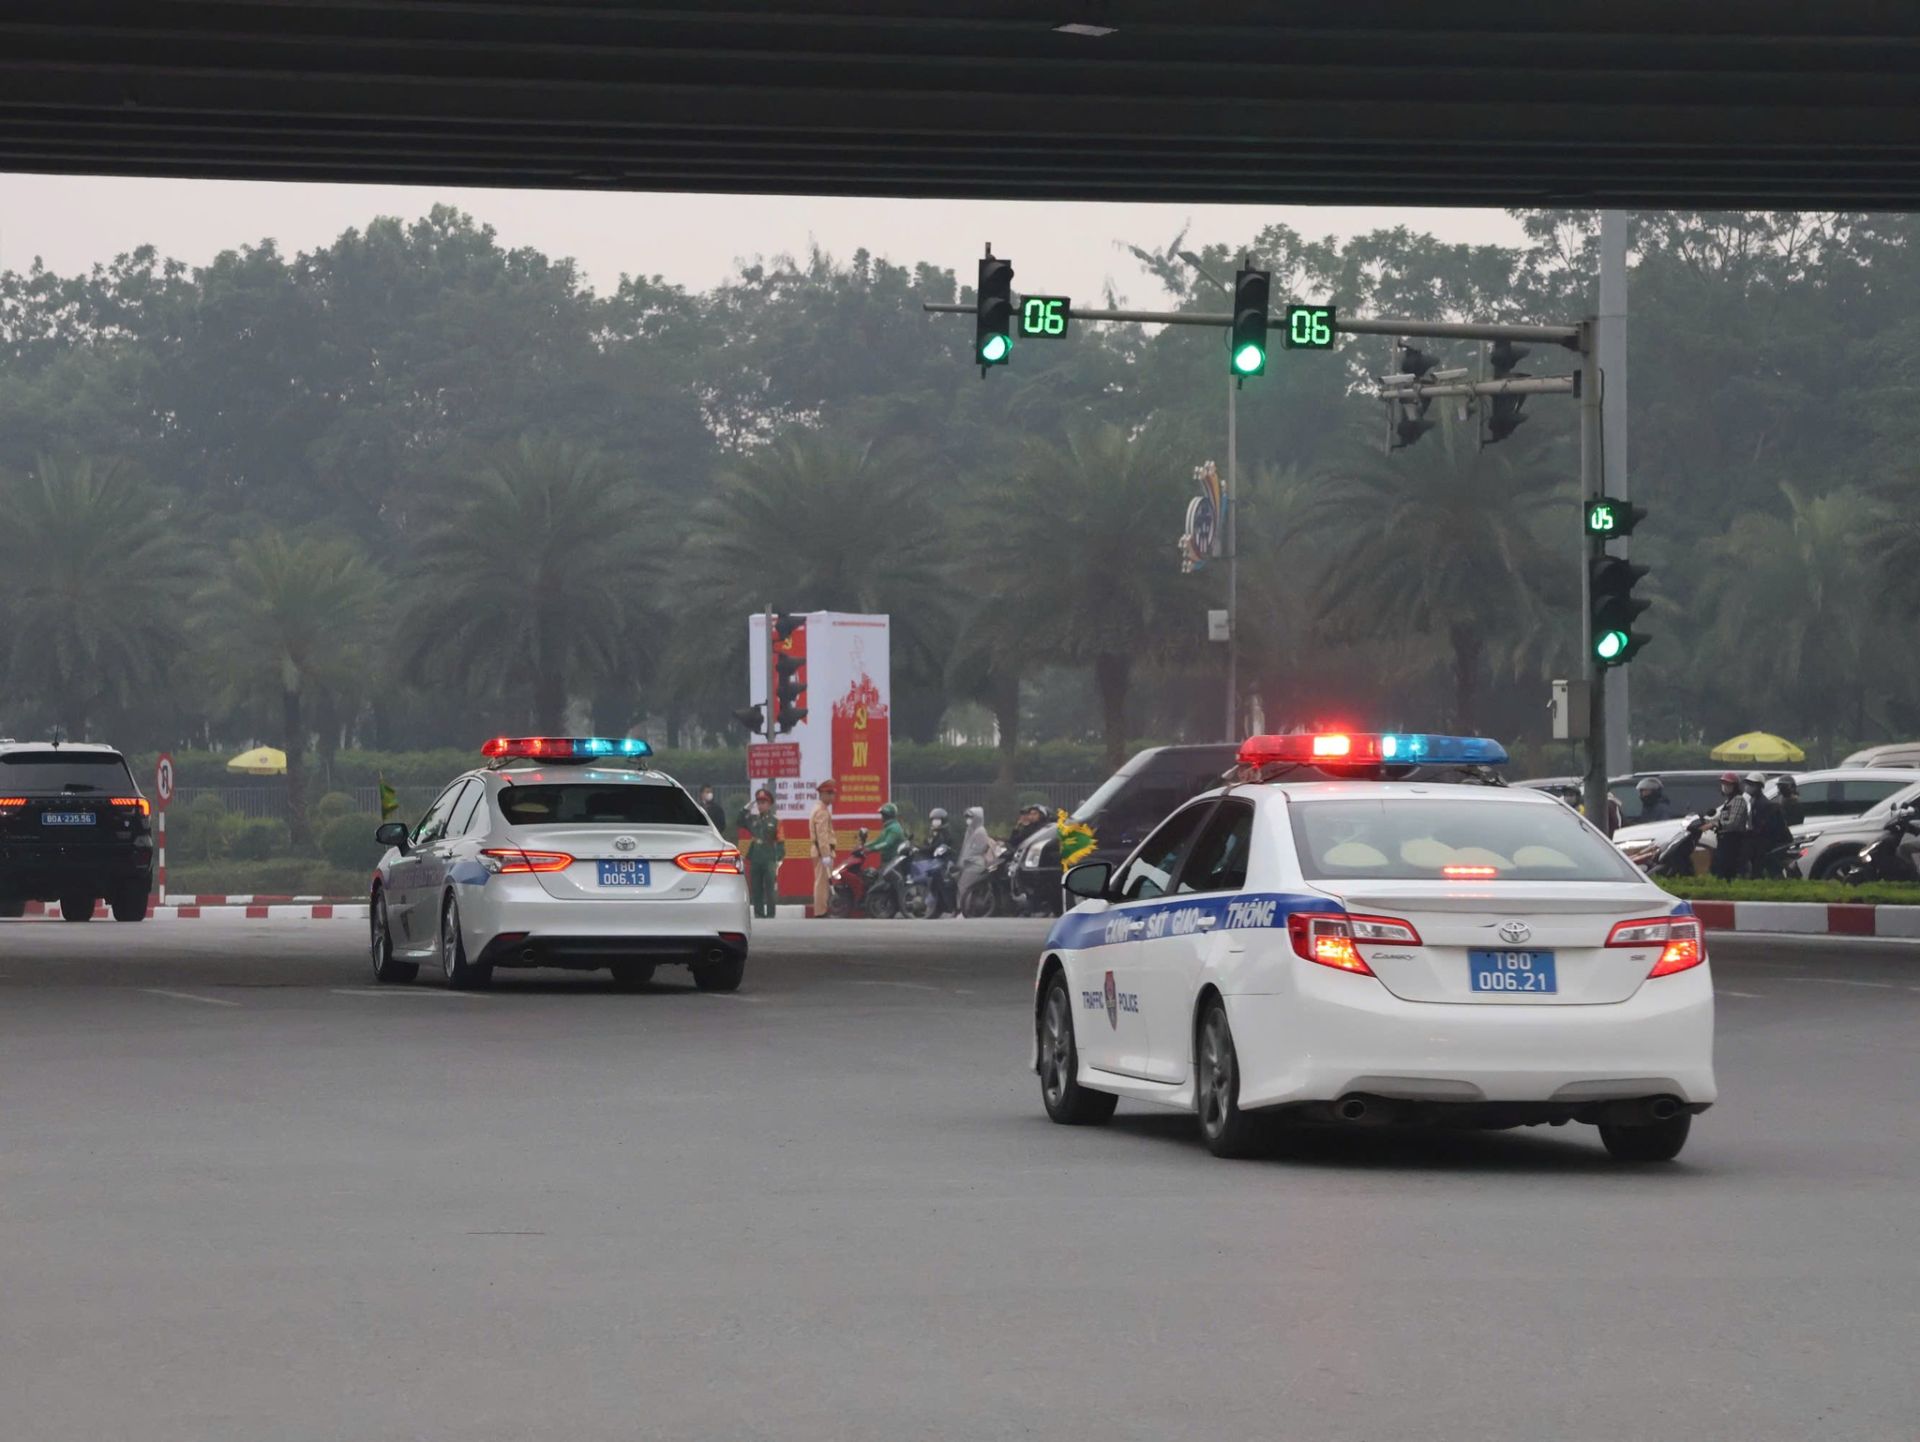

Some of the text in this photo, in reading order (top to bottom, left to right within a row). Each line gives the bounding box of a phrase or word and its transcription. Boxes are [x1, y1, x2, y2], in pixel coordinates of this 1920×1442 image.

[1024, 299, 1063, 335] 06
[1291, 309, 1330, 345] 06
[1591, 507, 1614, 529] 05
[852, 742, 868, 767] XIV
[613, 861, 635, 872] T80
[604, 874, 645, 884] 006.13
[1225, 898, 1276, 928] THÔNG
[1494, 953, 1531, 970] T80
[1479, 972, 1546, 990] 006.21
[1118, 993, 1139, 1013] POLICE
